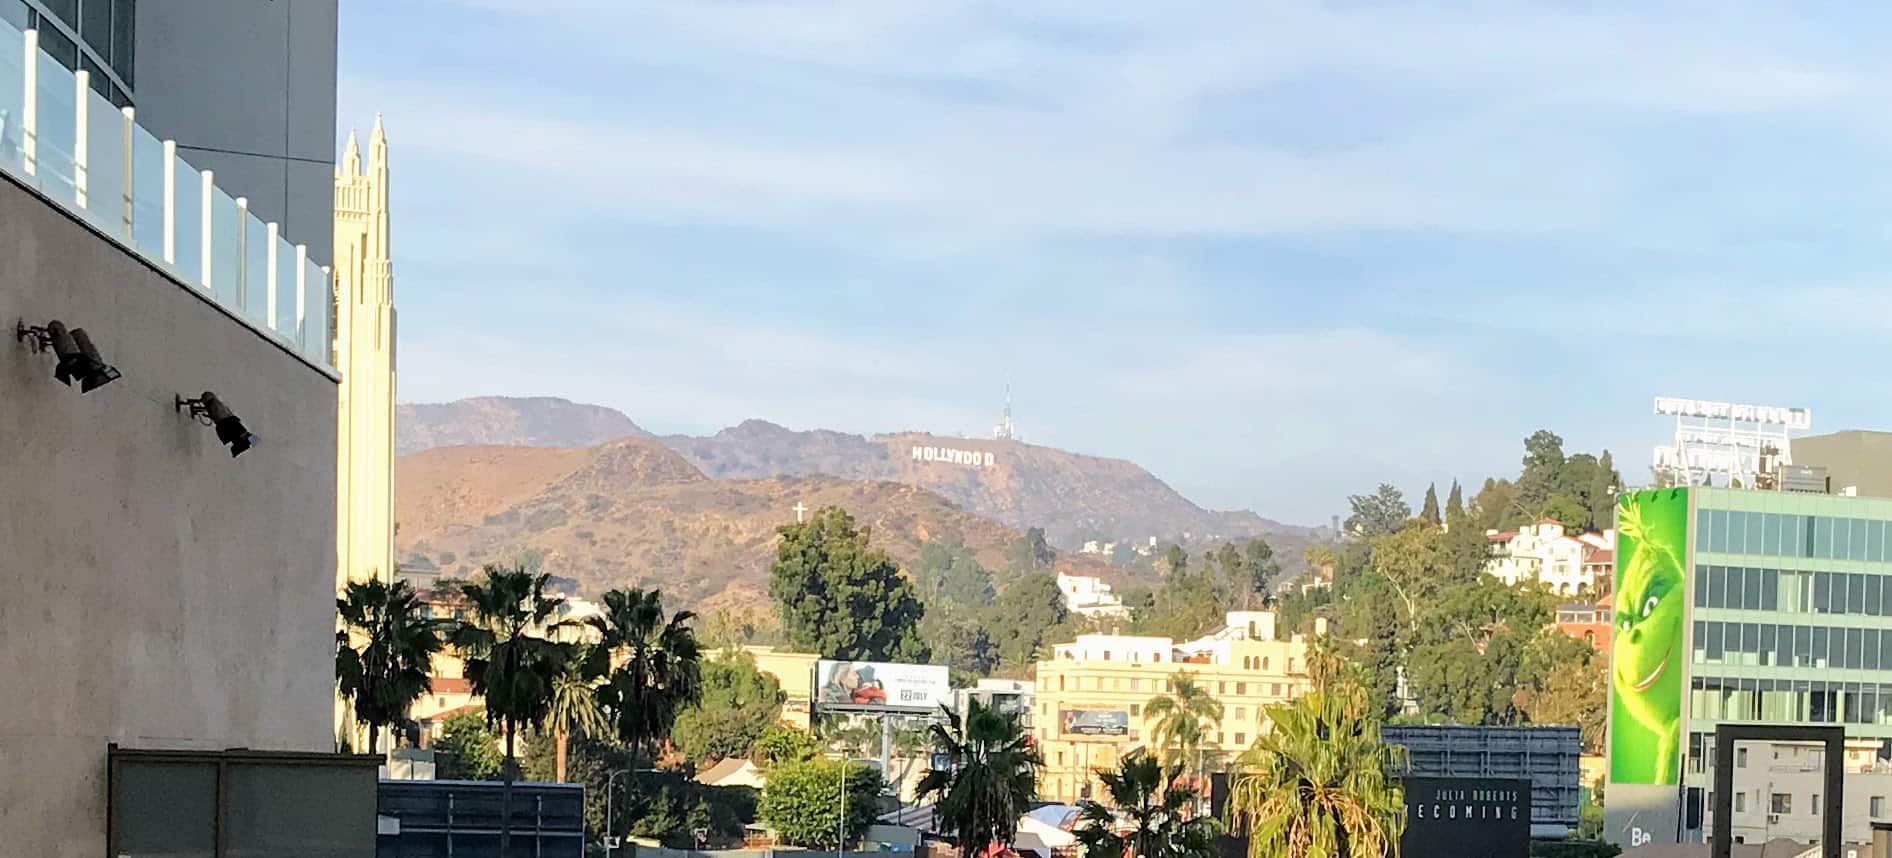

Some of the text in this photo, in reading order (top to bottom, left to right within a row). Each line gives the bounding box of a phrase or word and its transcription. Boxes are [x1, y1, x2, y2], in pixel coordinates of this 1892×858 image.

[912, 446, 994, 466] HOLLYWOOD
[1436, 789, 1518, 802] JULIA ROBERTS
